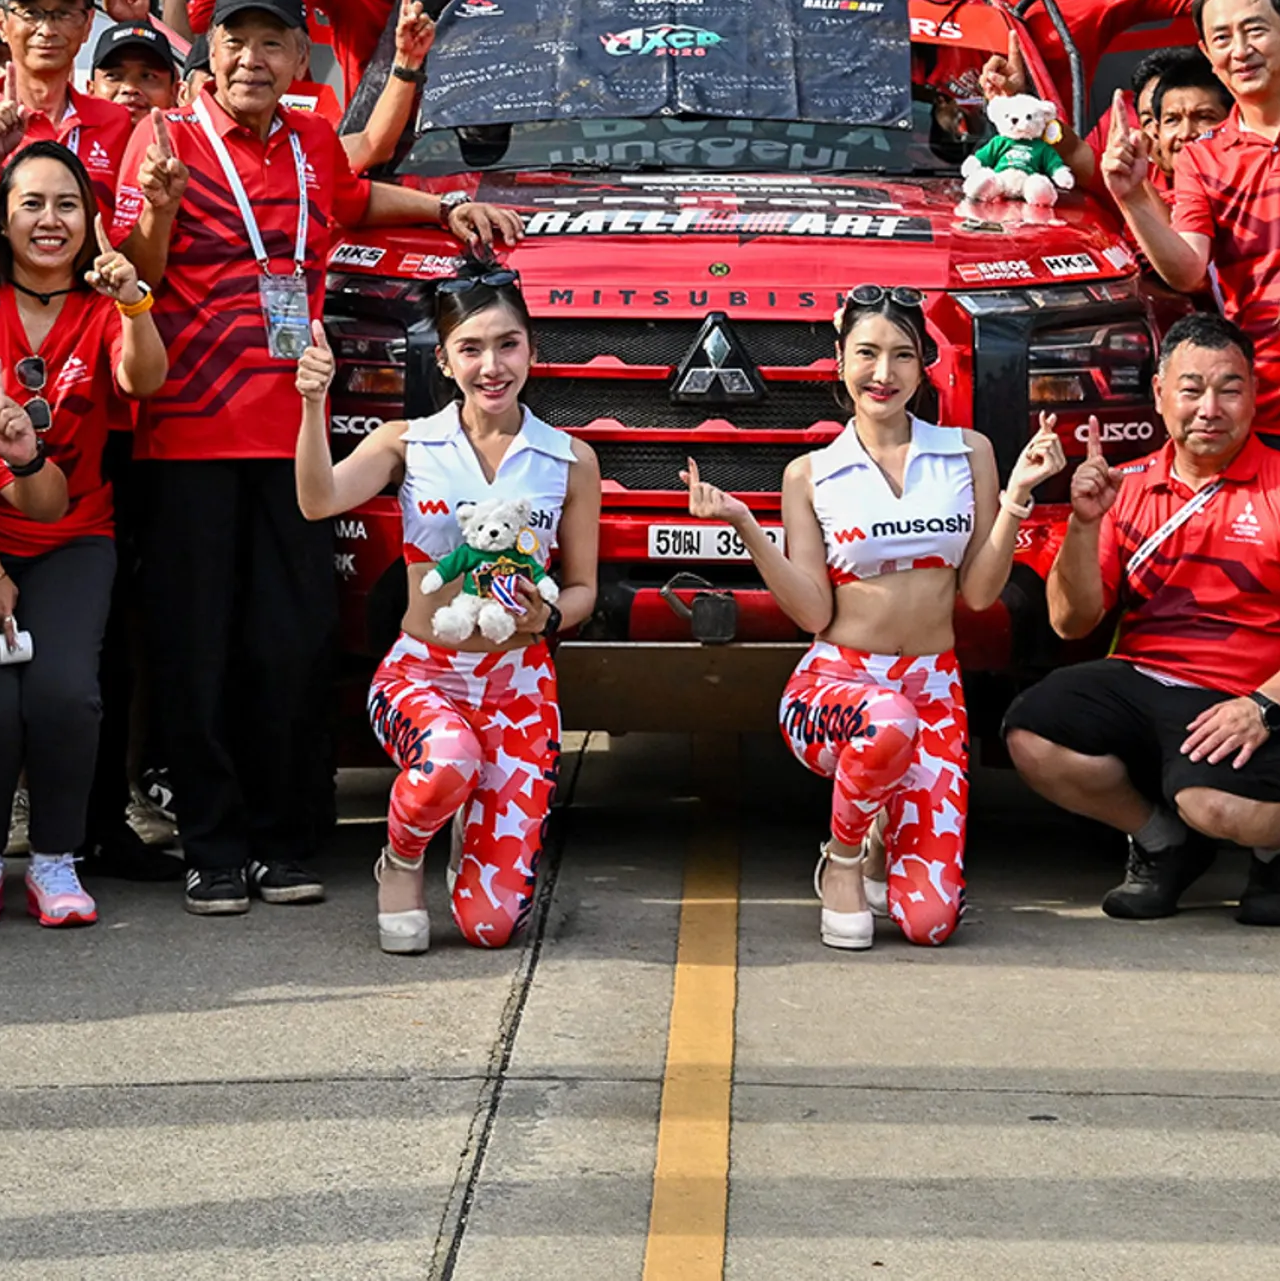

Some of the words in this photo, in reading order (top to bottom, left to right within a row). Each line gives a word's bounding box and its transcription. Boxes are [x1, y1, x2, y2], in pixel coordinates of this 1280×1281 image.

[524, 209, 910, 238] RALLIART
[336, 245, 383, 261] HKS
[978, 260, 1031, 273] ENEOS
[1045, 255, 1094, 270] HKS
[872, 514, 972, 538] musashi
